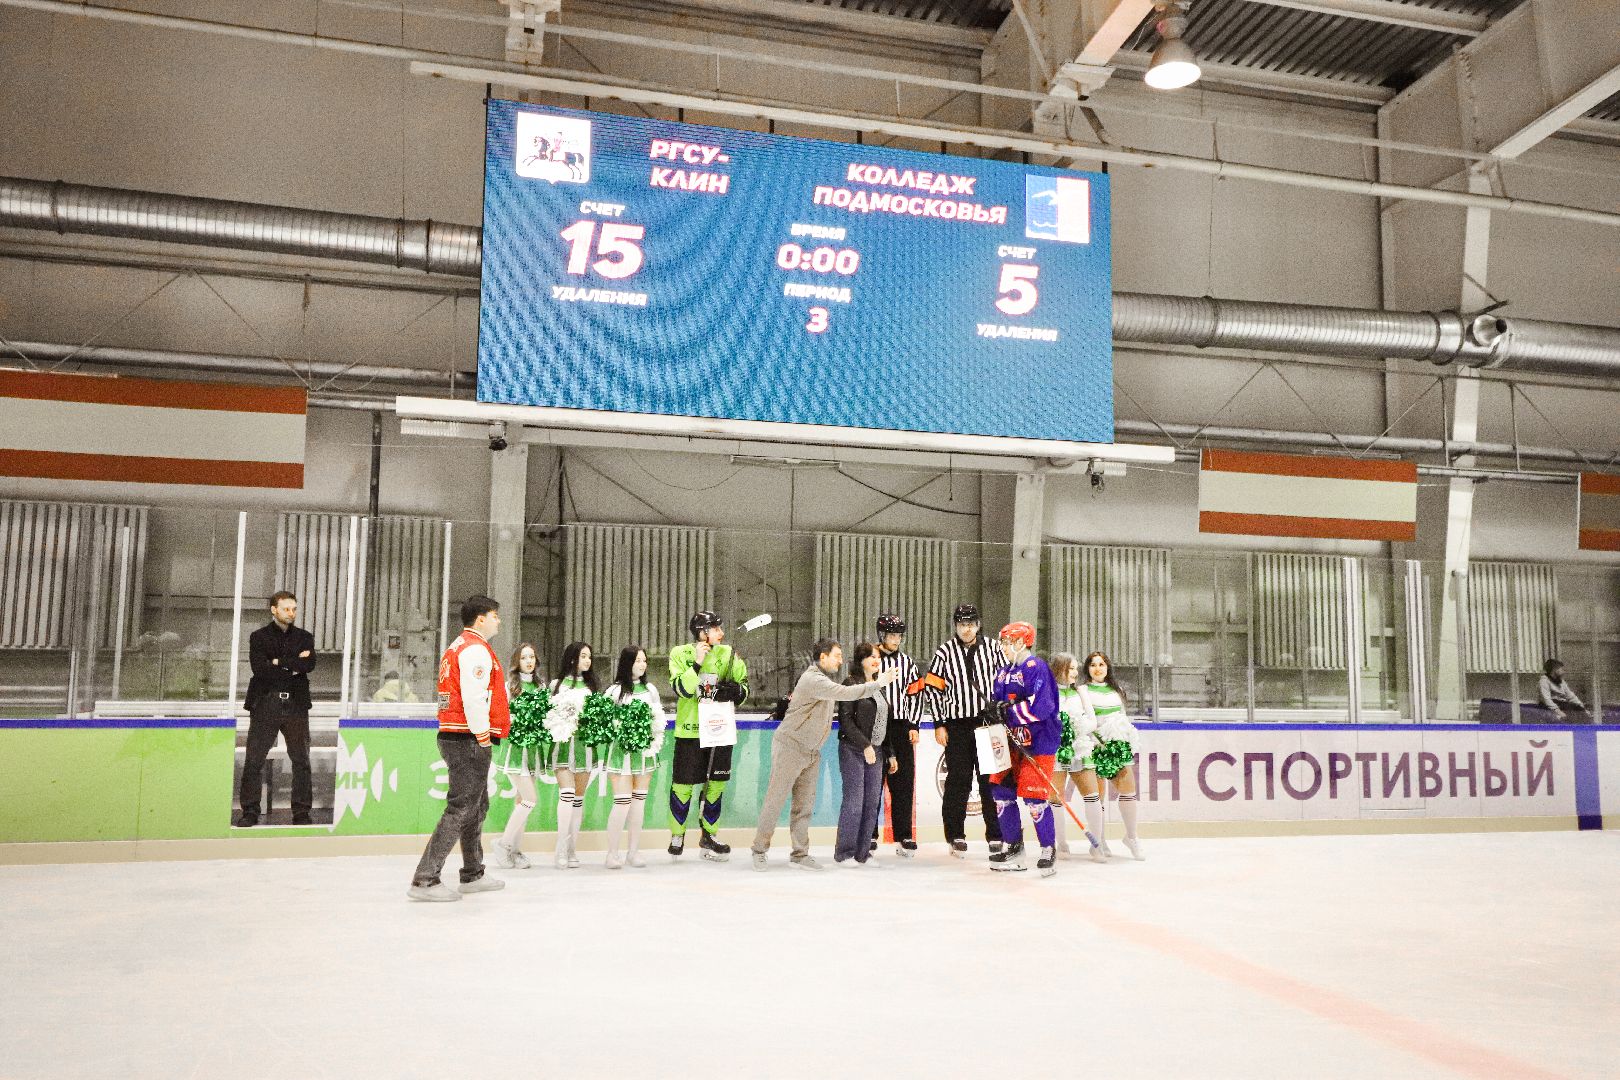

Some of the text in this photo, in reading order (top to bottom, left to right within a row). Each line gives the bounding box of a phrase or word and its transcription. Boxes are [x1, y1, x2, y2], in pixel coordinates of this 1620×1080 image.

[650, 139, 730, 165] РГСУ-
[650, 168, 730, 194] КЛИН
[847, 163, 977, 195] КОЛЛЕДЖ
[579, 201, 626, 217] СЧЕТ
[813, 186, 1008, 224] ПОДМОСКОВЬЯ
[560, 220, 646, 280] 15
[777, 243, 860, 275] 0:00
[997, 245, 1037, 260] СЧЕТ
[552, 286, 648, 307] УДАЛЕНИЯ
[783, 283, 851, 304] ПЕРИОД
[994, 263, 1040, 316] 5
[805, 307, 828, 334] 3
[976, 323, 1058, 342] УДАЛЕНИЯ
[1197, 740, 1555, 801] СПОРТИВНЫЙ
